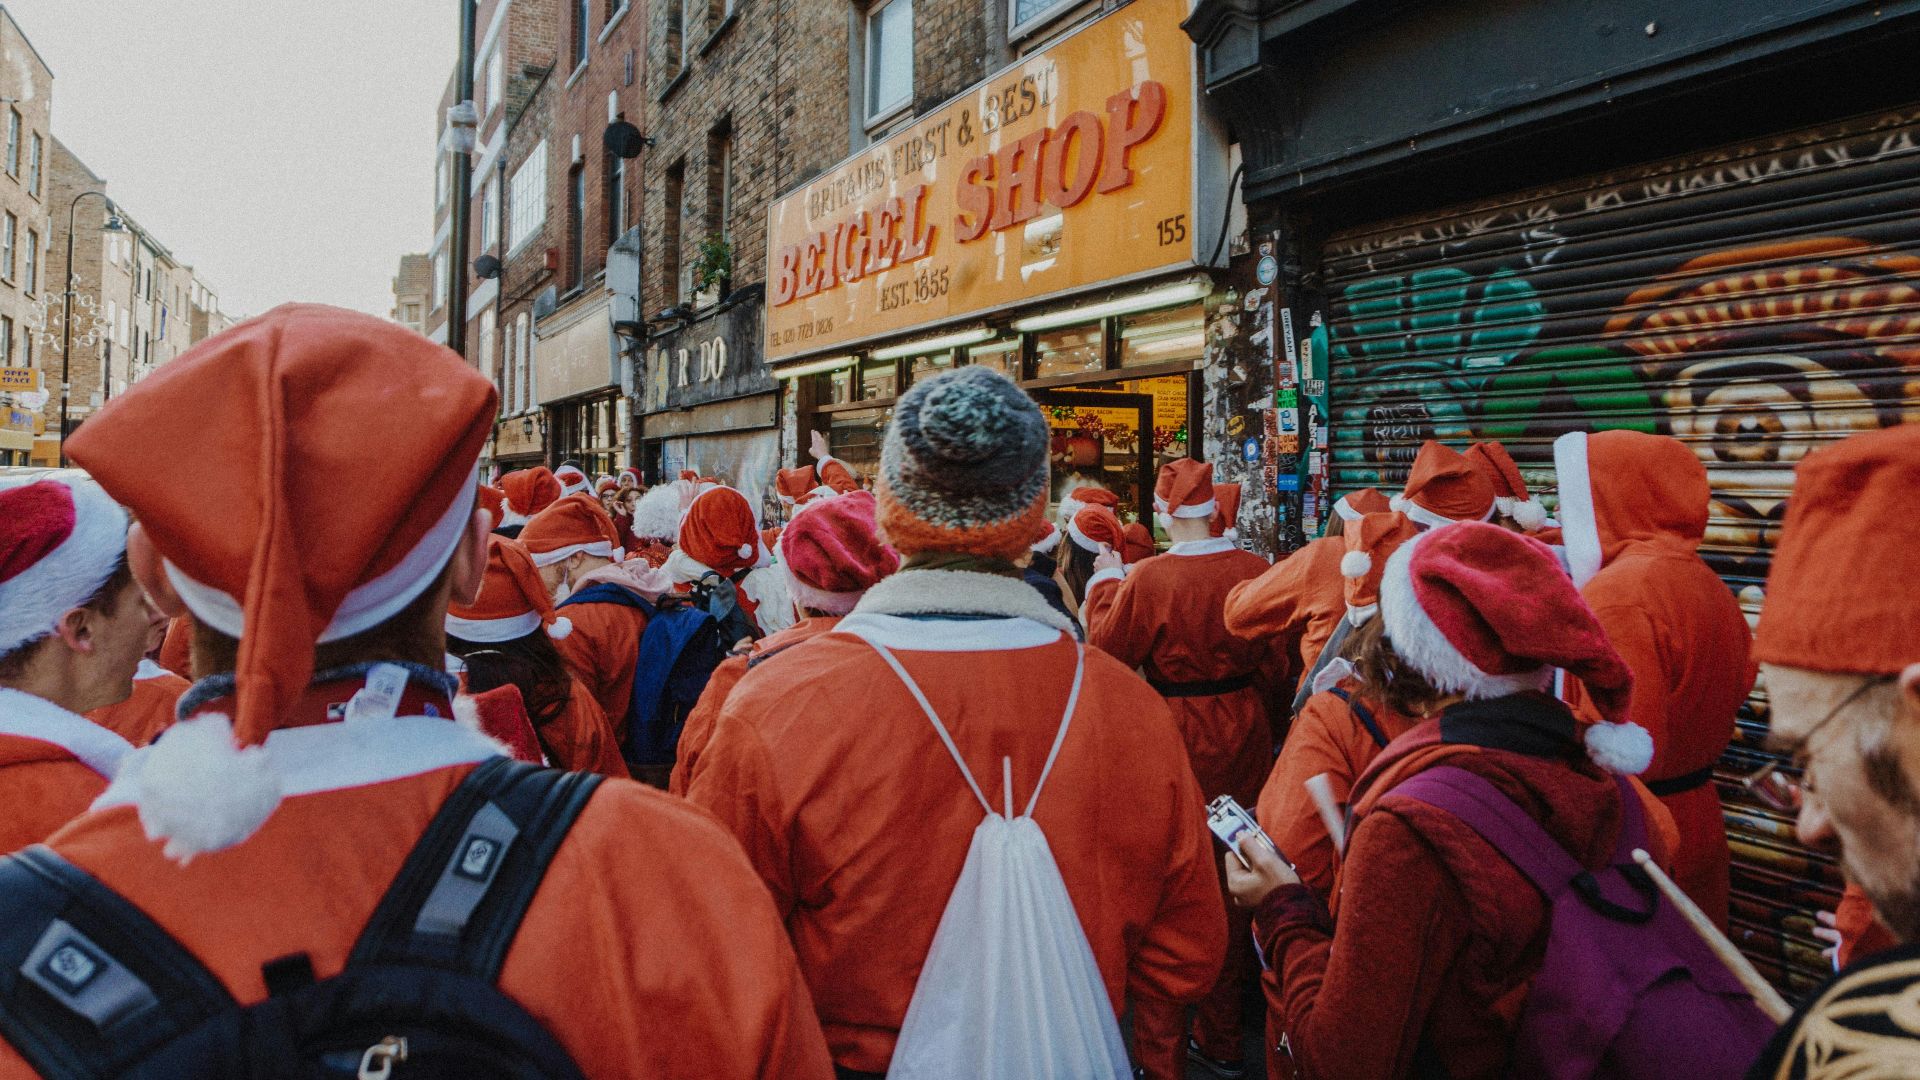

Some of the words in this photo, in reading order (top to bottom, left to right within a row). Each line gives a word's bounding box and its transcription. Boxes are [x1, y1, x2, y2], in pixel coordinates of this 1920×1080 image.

[809, 158, 885, 222] BRITAINS
[893, 118, 951, 179] FIRST
[957, 109, 974, 147] &
[982, 61, 1056, 135] BEST
[773, 184, 937, 307] BEIGEL
[954, 80, 1167, 244] SHOP
[1157, 214, 1186, 246] 155
[881, 281, 910, 311] EST.
[914, 265, 949, 303] 1855
[678, 348, 689, 387] R
[699, 336, 726, 382] DO
